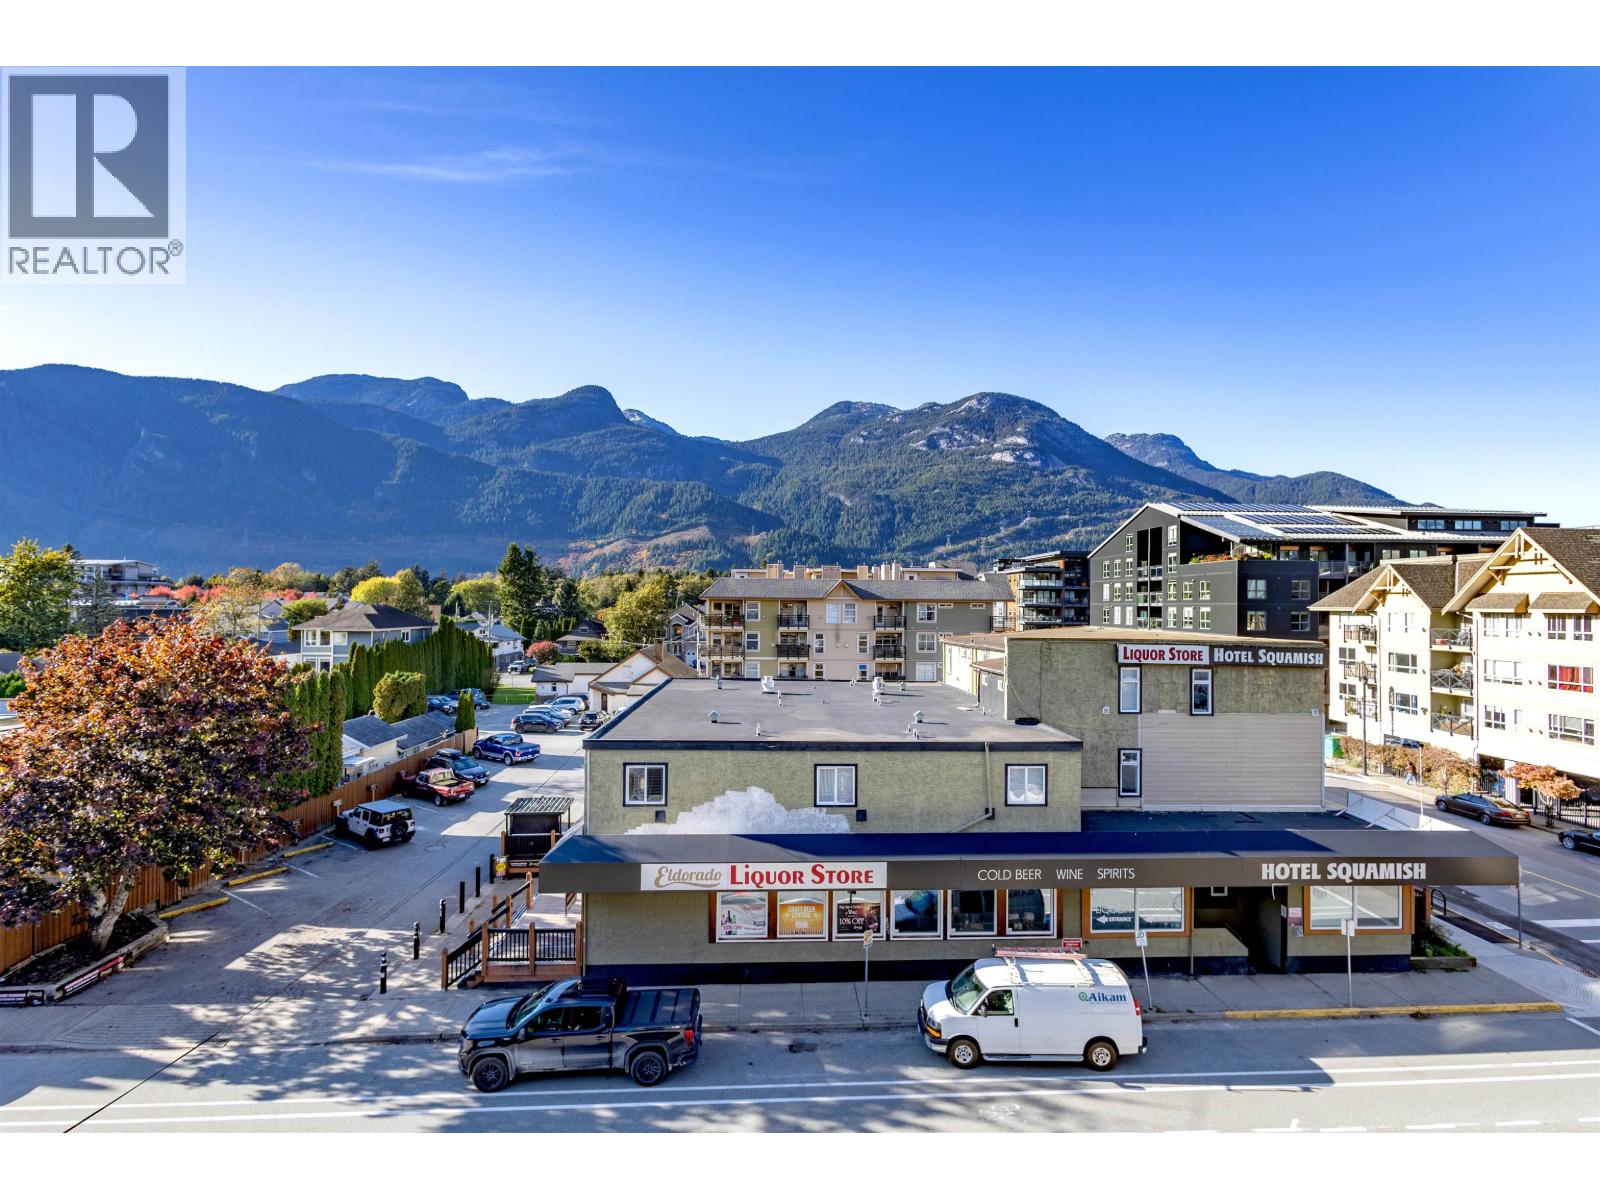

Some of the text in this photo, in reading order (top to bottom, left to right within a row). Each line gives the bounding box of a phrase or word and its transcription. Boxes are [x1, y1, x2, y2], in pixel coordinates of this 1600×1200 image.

[1122, 646, 1204, 663] LIQUOR STORE
[1213, 647, 1324, 666] HOTEL SQUAMISH
[655, 865, 722, 888] Eldorado
[810, 864, 875, 885] STORE
[977, 867, 1135, 881] COLD BEER WINE SPIRITS
[1261, 862, 1427, 883] HOTEL SQUAMISH
[1088, 992, 1127, 1002] Aikam
